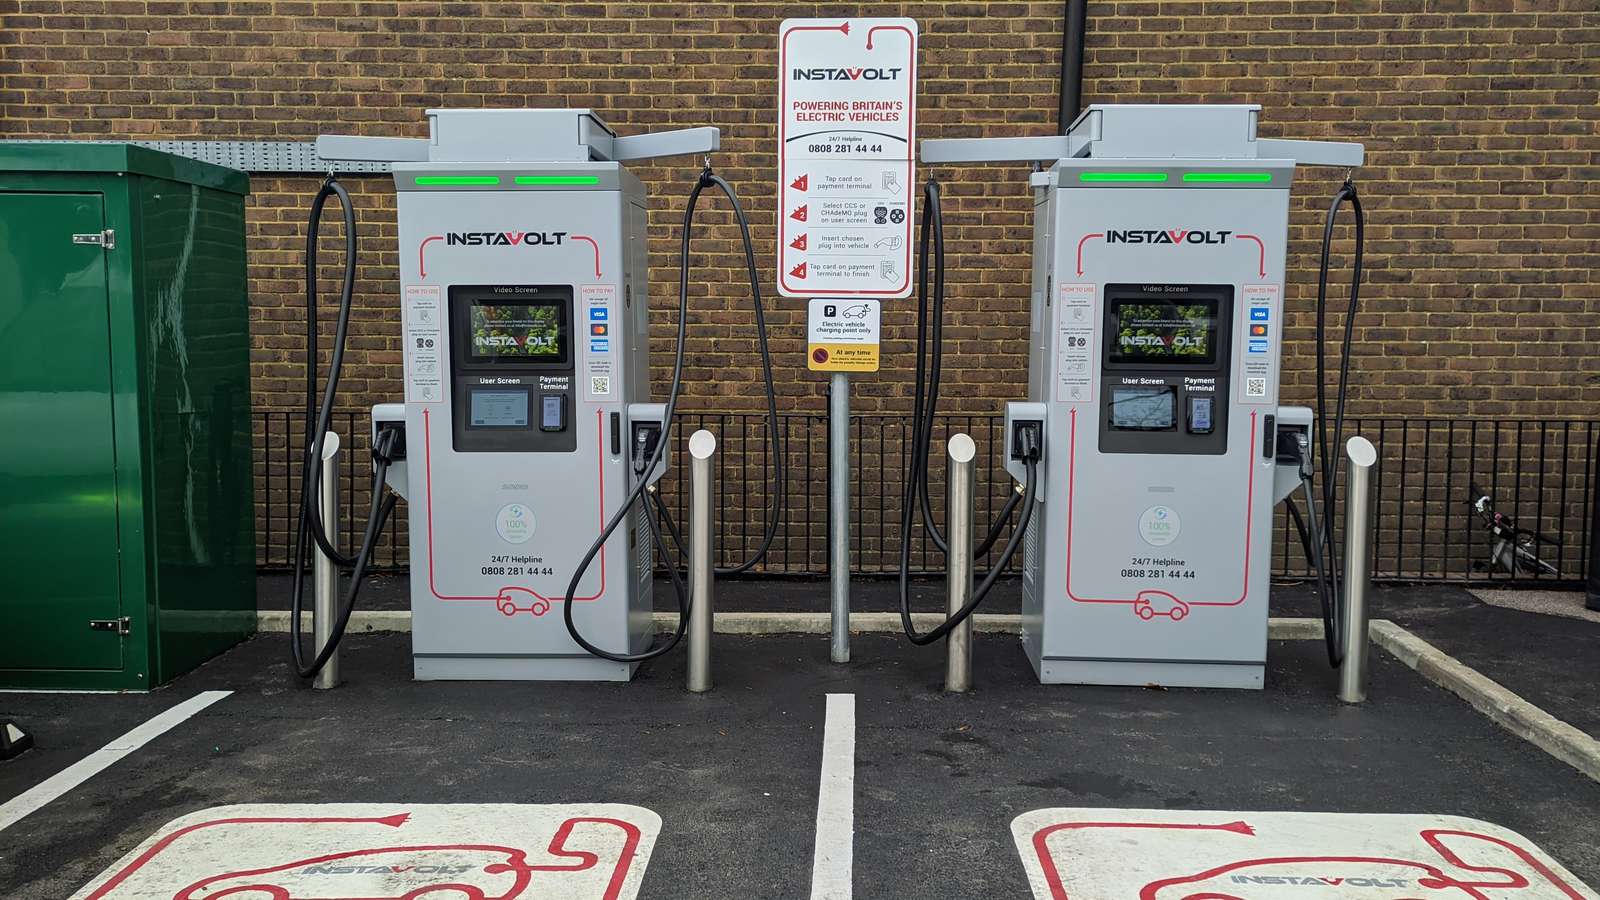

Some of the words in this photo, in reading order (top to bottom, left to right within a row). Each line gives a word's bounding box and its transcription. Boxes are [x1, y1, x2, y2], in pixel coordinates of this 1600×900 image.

[793, 66, 902, 80] INSTAVOLT
[793, 101, 849, 110] POWERING
[852, 101, 903, 110] BRITAIN'S
[796, 112, 846, 121] ELECTRIC
[849, 112, 899, 121] VEHICLES
[808, 144, 832, 152] 0808
[835, 144, 851, 152] 281
[855, 144, 868, 152] 44
[870, 144, 882, 152] 44
[447, 231, 567, 246] INSTAVOLT
[1106, 229, 1232, 244] INSTAVOLT
[828, 307, 834, 316] P
[475, 336, 555, 346] INSTAVOLT
[1120, 336, 1204, 346] INSTAVOLT
[1184, 377, 1215, 385] Payment
[512, 556, 543, 564] Helpline
[1152, 558, 1186, 566] Helpline
[482, 567, 505, 576] 0808
[508, 567, 524, 576] 281
[527, 568, 539, 576] 44
[542, 568, 553, 576] 44
[1121, 569, 1145, 578] 0808
[1148, 570, 1165, 578] 281
[1168, 570, 1180, 578] 44
[1183, 570, 1195, 578] 44
[302, 865, 477, 874] INSTAVOLT
[1230, 875, 1408, 888] INSTAVOLT
